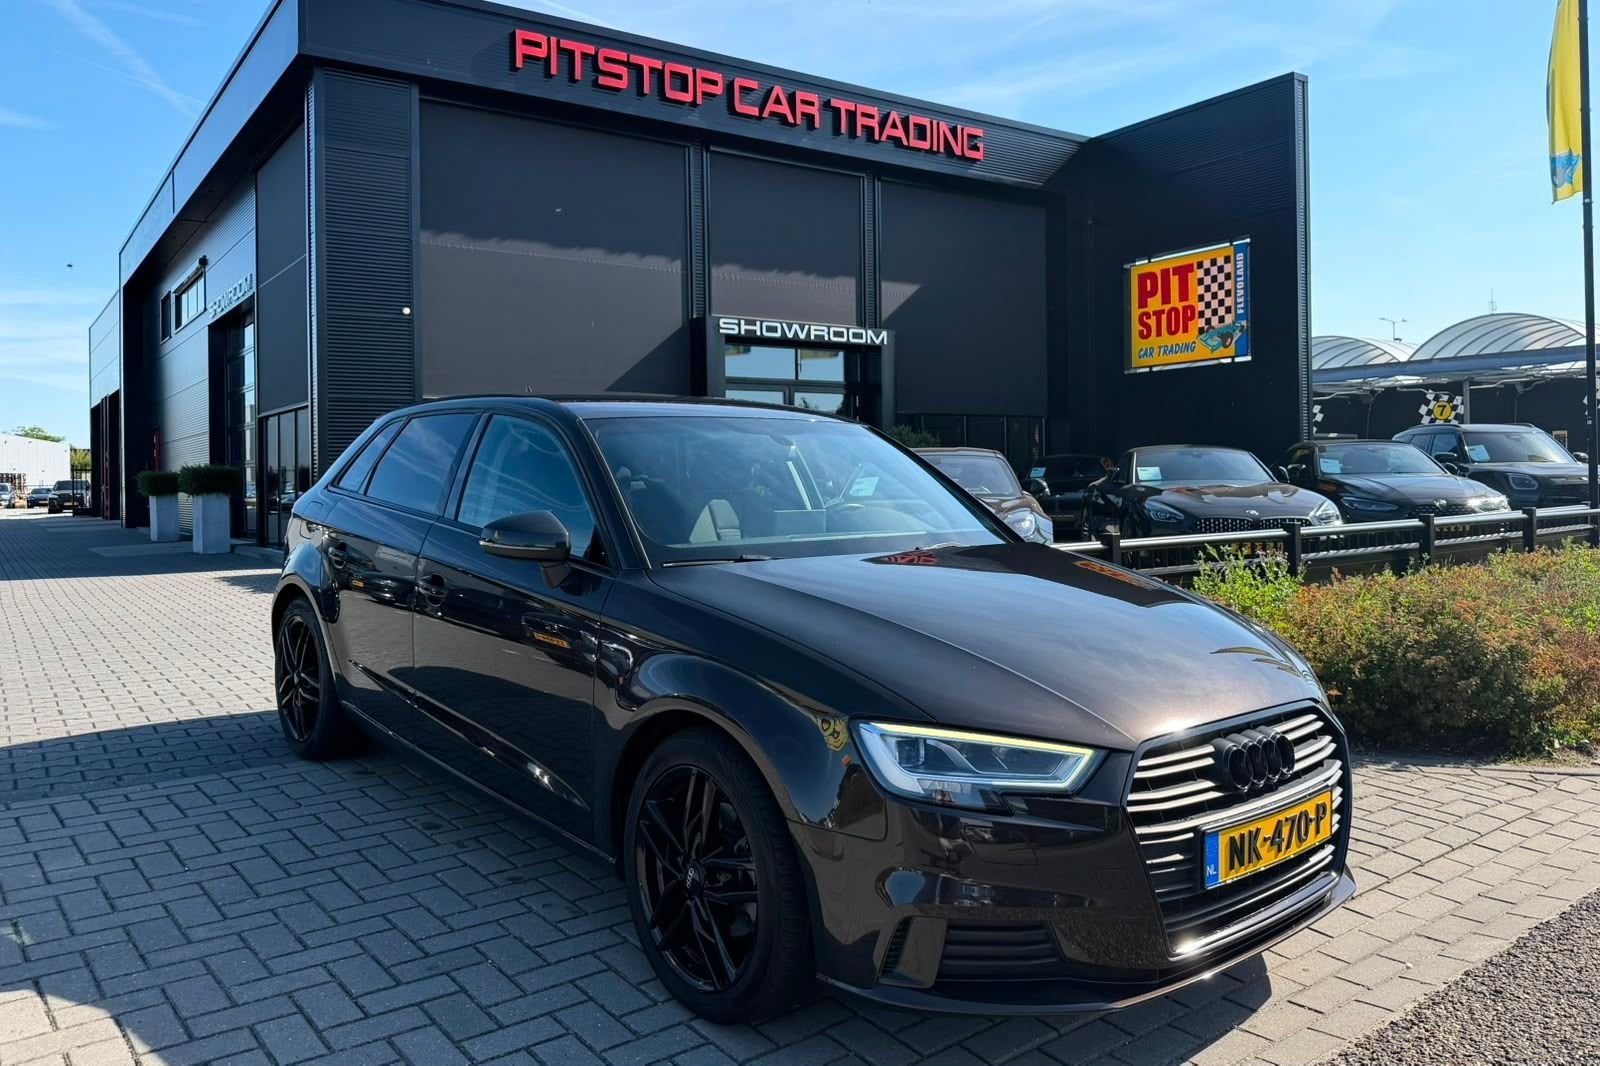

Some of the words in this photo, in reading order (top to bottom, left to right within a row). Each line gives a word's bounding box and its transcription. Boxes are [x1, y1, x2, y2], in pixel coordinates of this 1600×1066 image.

[514, 29, 724, 104] PITSTOP
[733, 78, 820, 129] CAR
[829, 98, 985, 161] TRADING
[1137, 262, 1195, 309] PIT
[1236, 252, 1244, 314] FLEVOLAND
[719, 318, 888, 345] SHOWROOM
[1138, 304, 1196, 340] STOP
[1138, 346, 1155, 359] CAR
[1157, 341, 1197, 357] TRADING
[1437, 404, 1447, 416] 7
[1228, 801, 1328, 872] NK-470-P
[1206, 864, 1217, 876] NL
